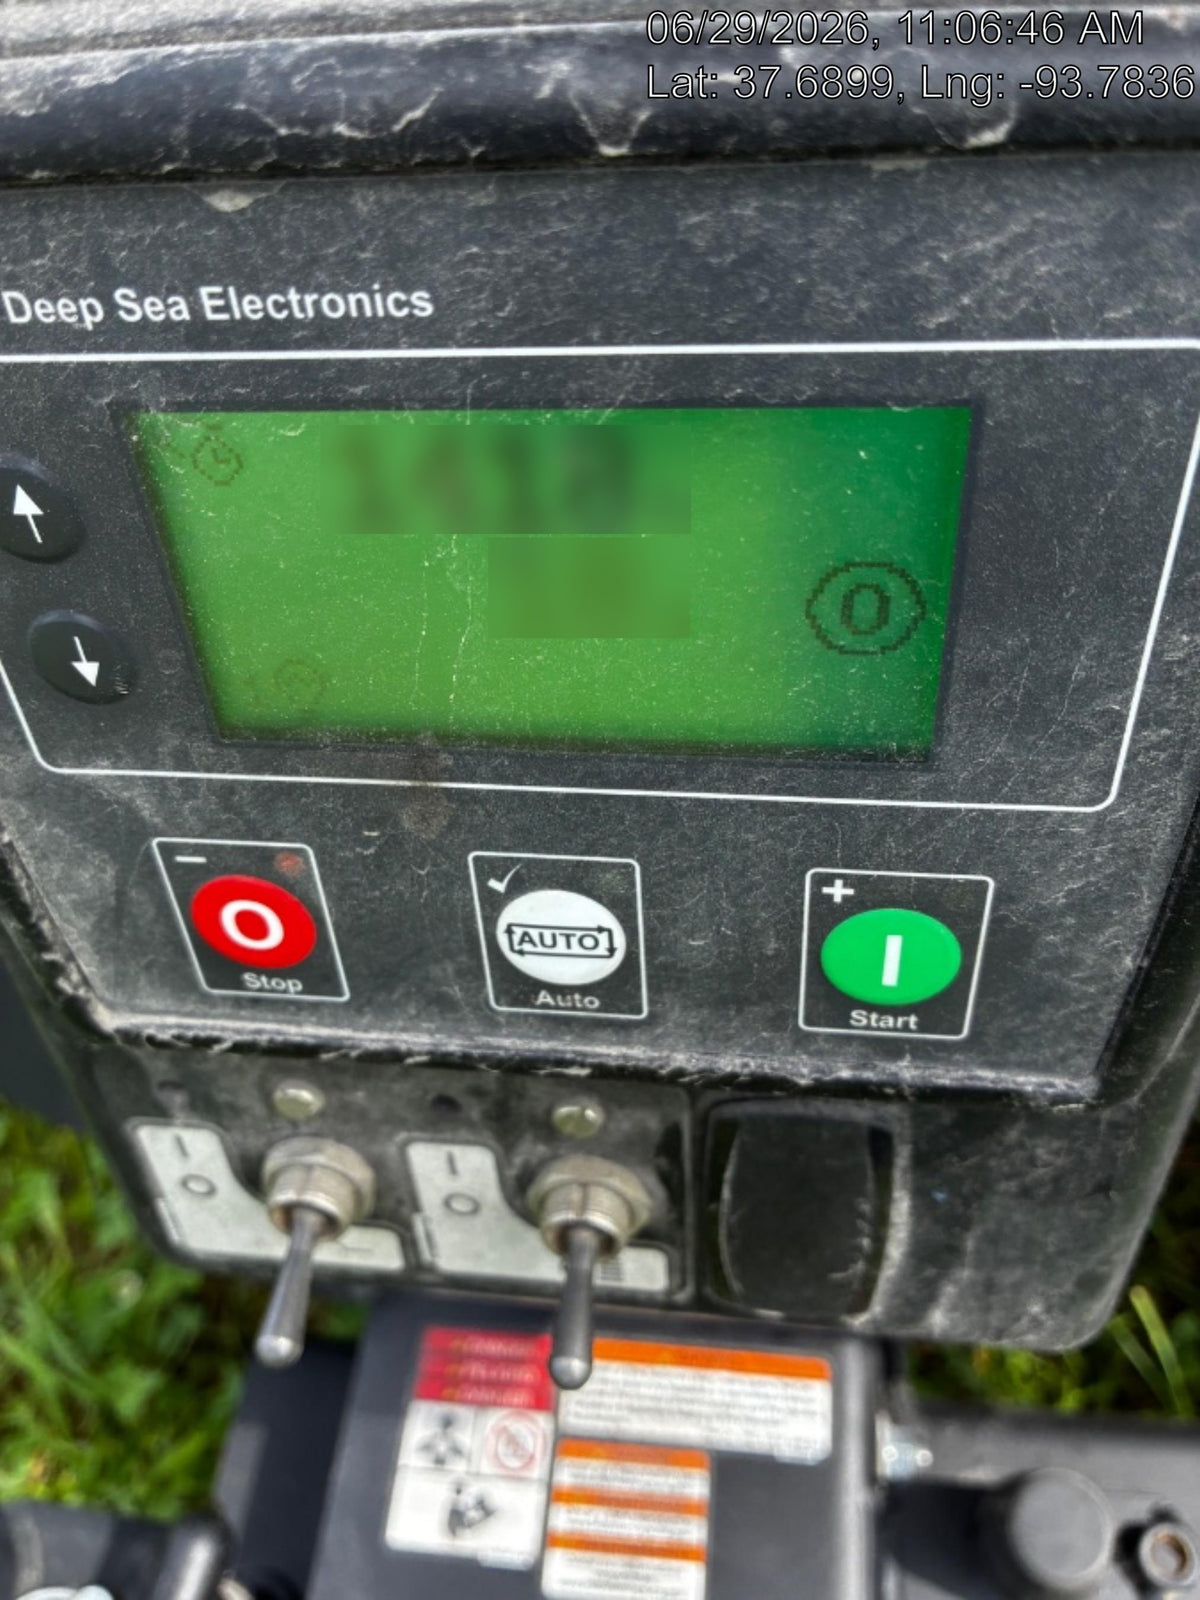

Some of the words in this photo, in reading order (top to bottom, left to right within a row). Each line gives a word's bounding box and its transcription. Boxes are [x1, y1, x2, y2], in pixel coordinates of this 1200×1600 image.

[4, 290, 104, 331] Deep
[113, 287, 191, 323] Sea
[201, 284, 434, 321] Electronics
[518, 929, 600, 952] AUTO
[242, 971, 303, 993] Stop
[535, 989, 600, 1010] Auto
[849, 1009, 919, 1030] Start
